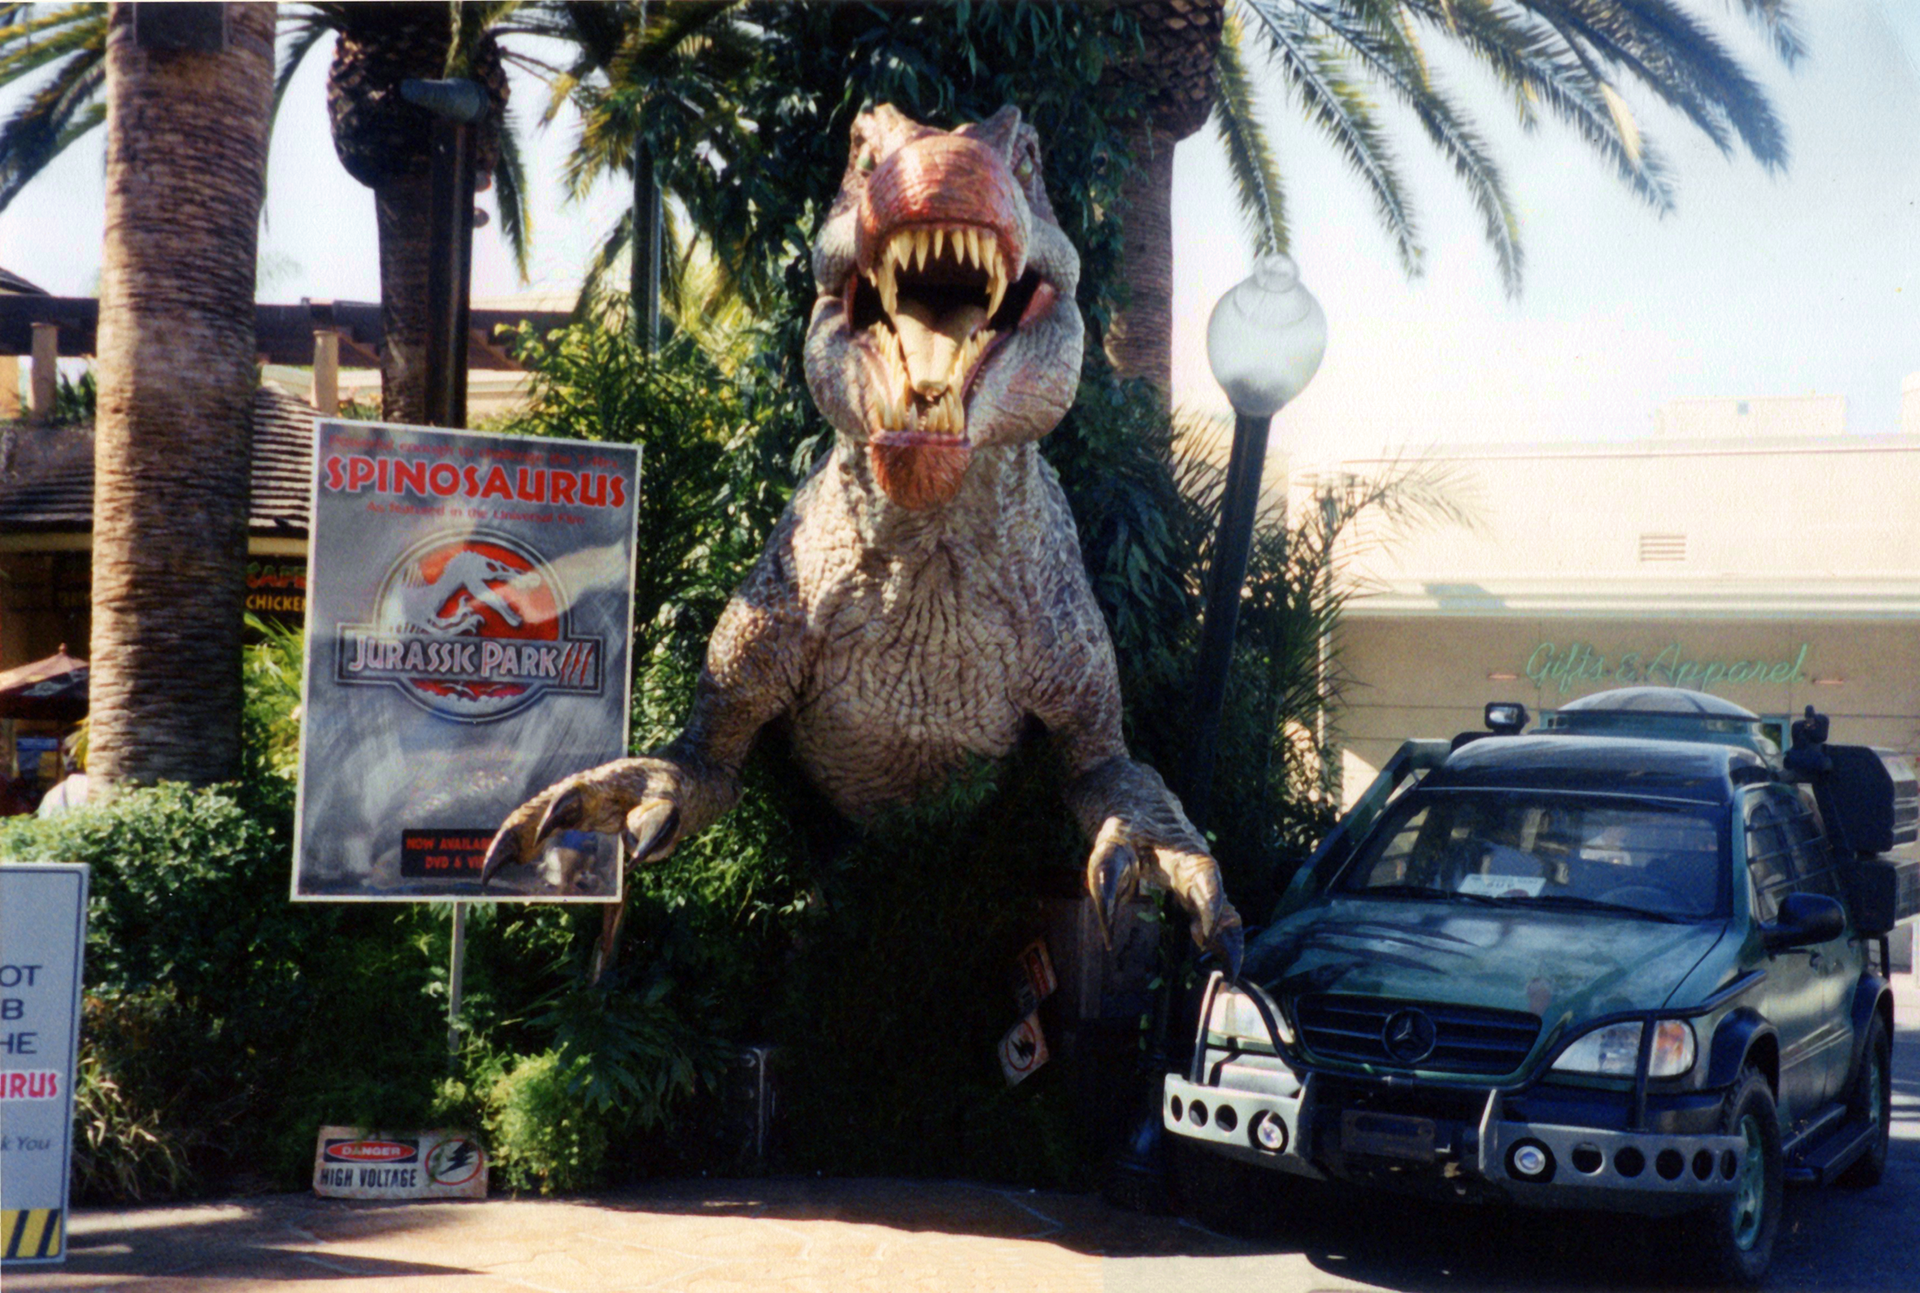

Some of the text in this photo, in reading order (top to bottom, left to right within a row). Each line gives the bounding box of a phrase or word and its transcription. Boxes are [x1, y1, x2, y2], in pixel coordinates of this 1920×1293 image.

[328, 434, 394, 451] Powerful
[399, 441, 453, 459] enough
[459, 446, 473, 458] to
[479, 447, 544, 466] challenge
[549, 453, 571, 465] the
[326, 455, 627, 509] SPINOSAURUS
[366, 500, 384, 513] As
[389, 501, 445, 517] featured
[450, 505, 463, 517] in
[467, 506, 487, 519] the
[494, 510, 553, 524] Universal
[348, 635, 476, 673] JURASSIC
[481, 641, 557, 677] PARK
[1525, 642, 1808, 694] Gifts & Apparel
[406, 838, 435, 850] NOW
[425, 856, 449, 869] DVD
[0, 965, 43, 987] OT
[1, 998, 24, 1020] B
[17, 1135, 51, 1151] You
[341, 1146, 401, 1156] DANGER
[320, 1168, 417, 1187] HIGH VOLTAGE
